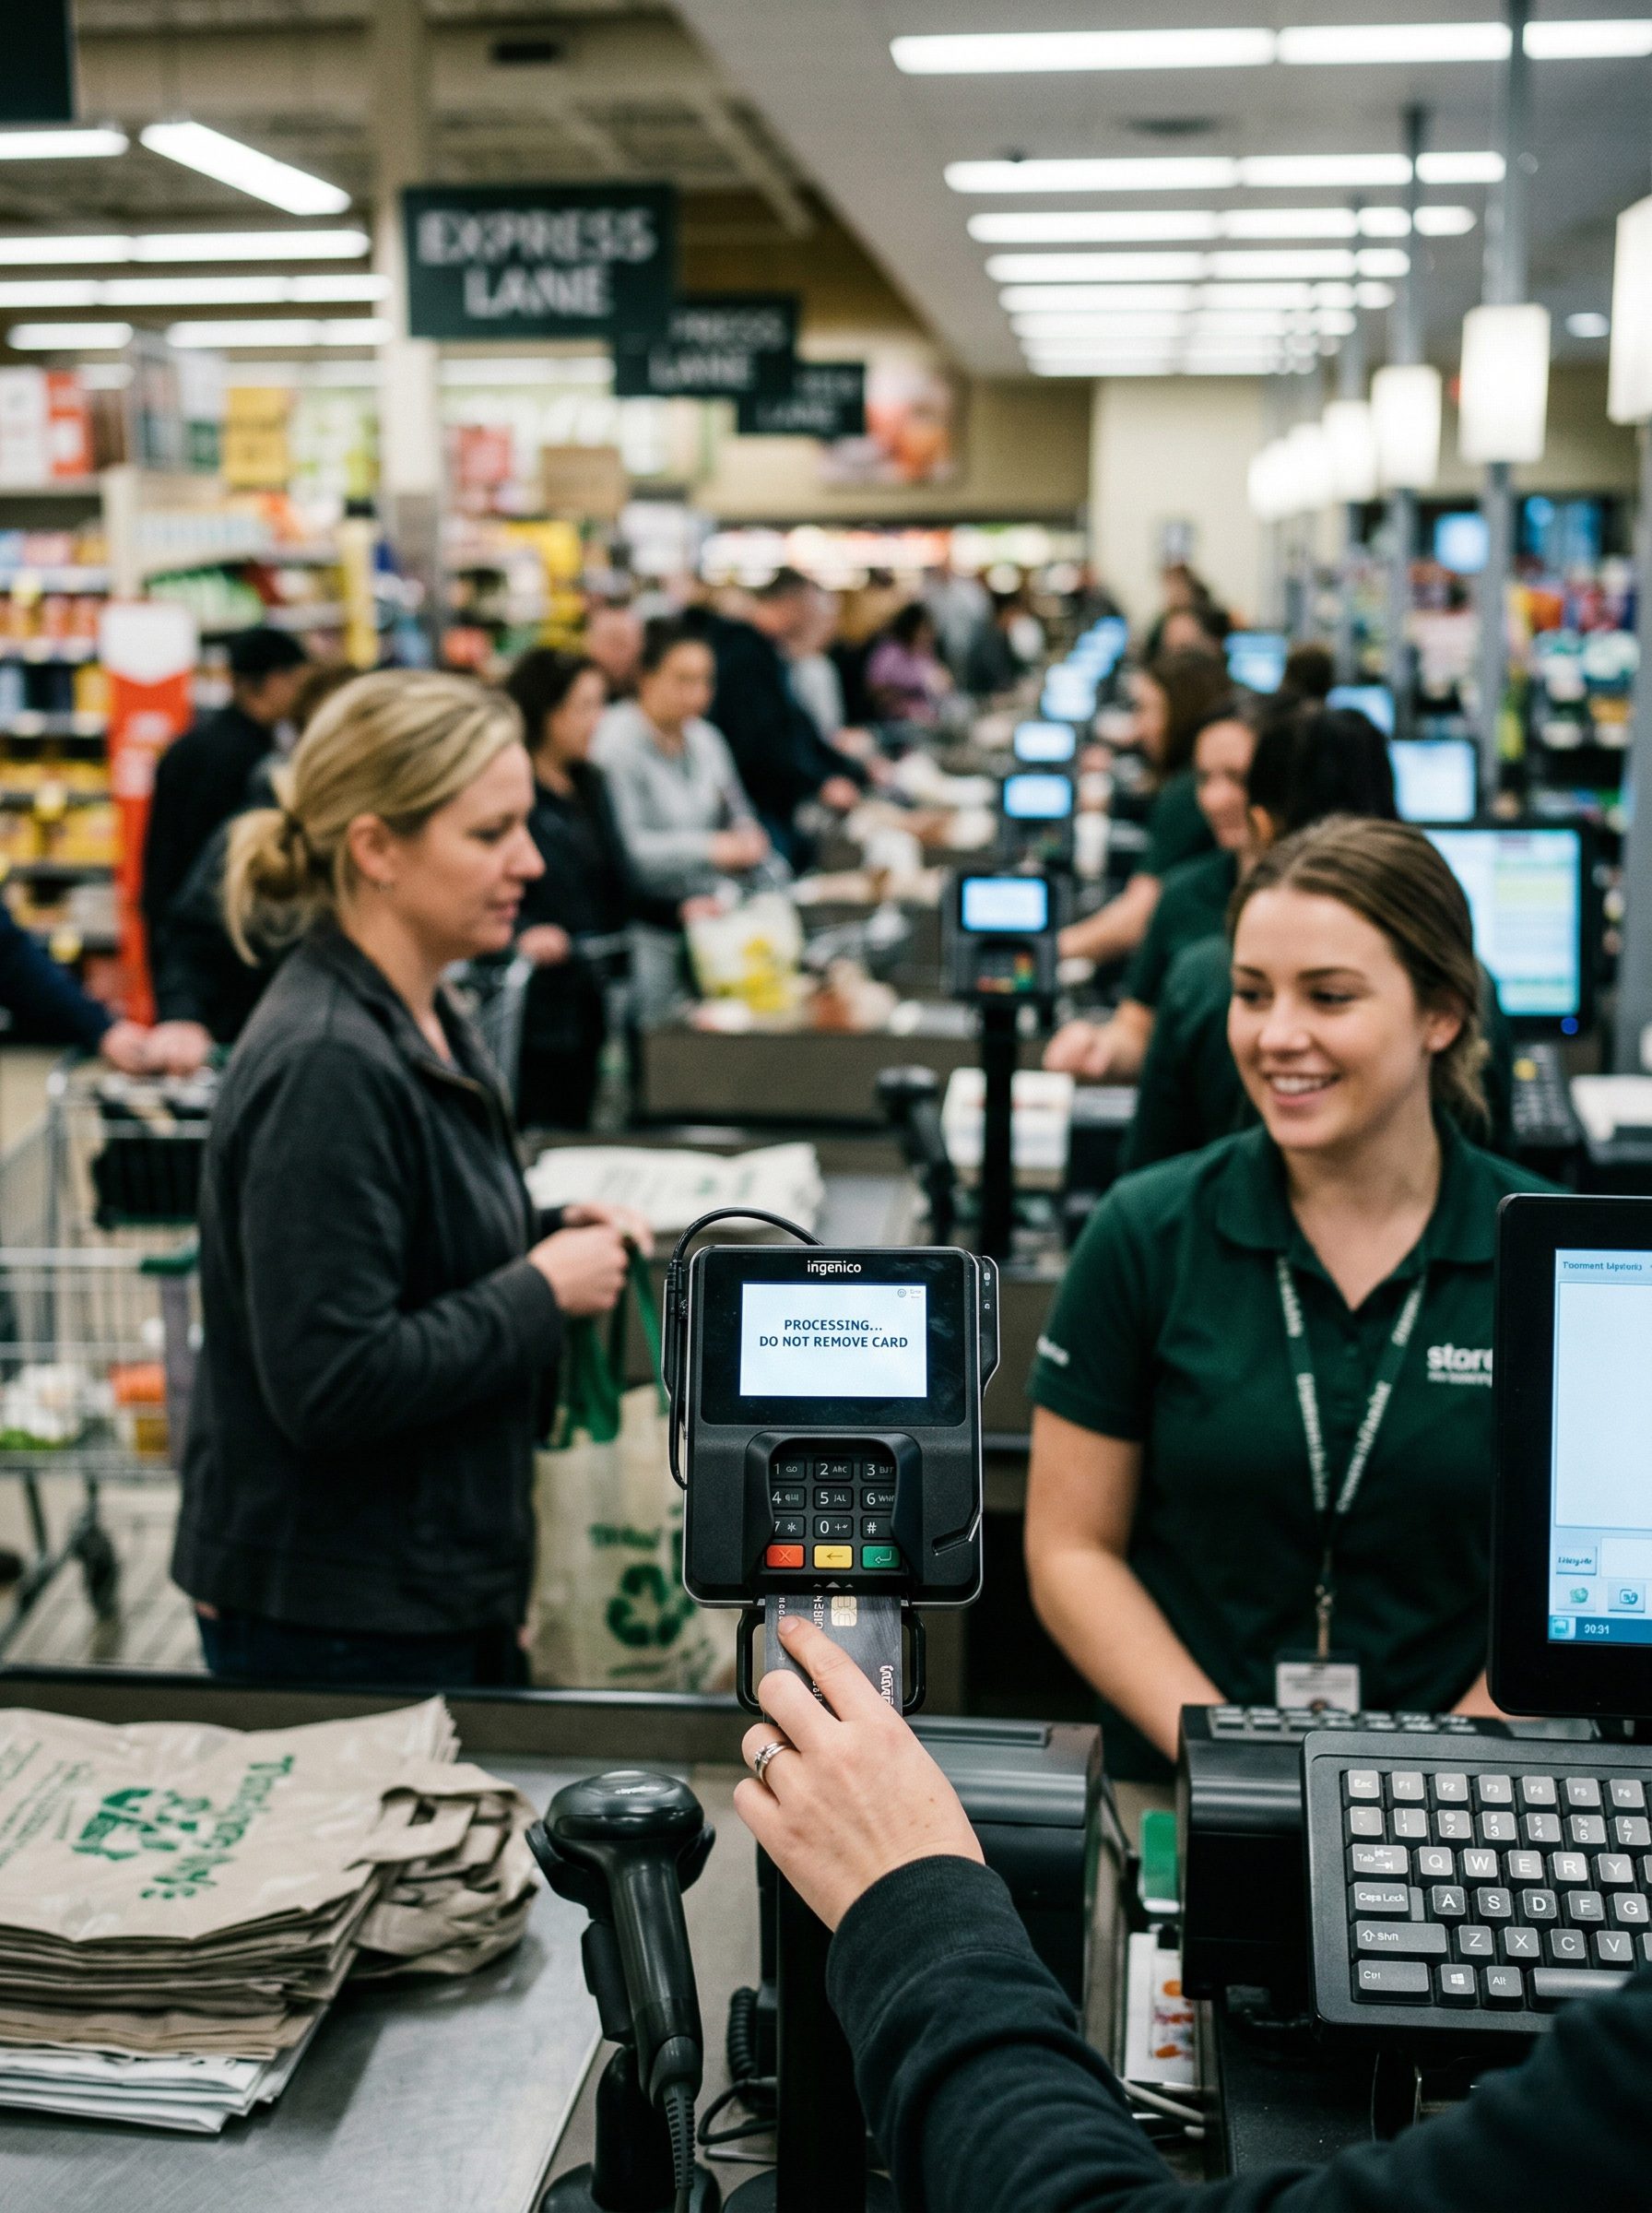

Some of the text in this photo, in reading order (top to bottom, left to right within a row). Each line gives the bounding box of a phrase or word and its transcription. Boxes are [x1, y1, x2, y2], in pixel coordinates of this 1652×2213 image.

[417, 208, 655, 264] EXPRESS
[465, 266, 612, 318] LANE
[807, 1260, 862, 1275] ingenico
[784, 1320, 883, 1331] PROCESSING...
[760, 1336, 908, 1348] DO NOT REMOVE CARD
[774, 1463, 780, 1474] 1
[820, 1463, 829, 1475] 2
[867, 1464, 876, 1475] 3
[772, 1491, 782, 1504] 4
[820, 1492, 829, 1504] 5
[867, 1493, 876, 1505] 6
[820, 1521, 830, 1533] 0
[867, 1521, 877, 1533] #
[1398, 1781, 1410, 1790] F1
[1442, 1782, 1456, 1792] F2
[1486, 1784, 1499, 1793] F3
[1530, 1785, 1543, 1794] F4
[1575, 1787, 1587, 1796] F5
[1618, 1789, 1632, 1798] F6
[1401, 1822, 1632, 1842] 1 2 3 4 6 7
[1428, 1854, 1443, 1869] Q
[1471, 1856, 1490, 1871] W
[1518, 1859, 1532, 1873] E
[1563, 1860, 1577, 1875] R
[1608, 1862, 1622, 1876] Y
[1442, 1893, 1457, 1908] A
[1488, 1895, 1501, 1910] S
[1532, 1897, 1547, 1911] D
[1579, 1899, 1591, 1913] F
[1623, 1900, 1638, 1915] G
[1469, 1933, 1483, 1947] Z
[1515, 1935, 1528, 1949] X
[1561, 1936, 1575, 1951] C
[1606, 1938, 1620, 1953] V
[1493, 1976, 1506, 1985] Alt
